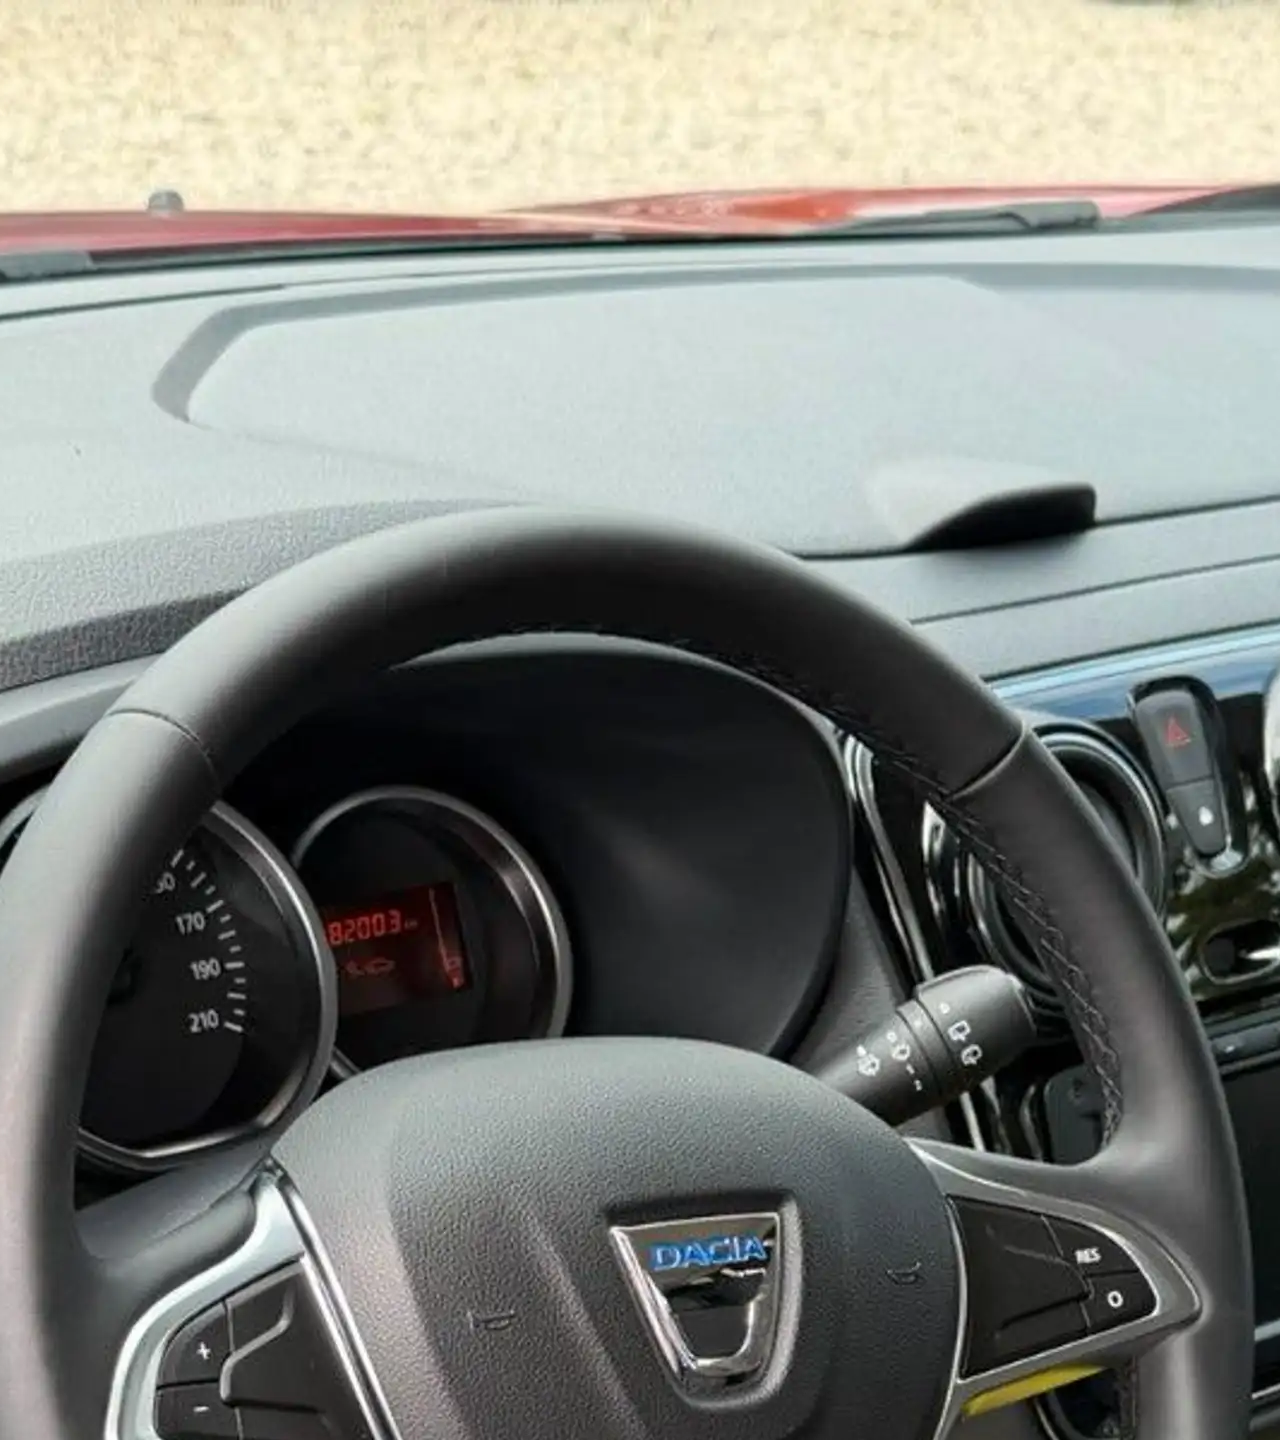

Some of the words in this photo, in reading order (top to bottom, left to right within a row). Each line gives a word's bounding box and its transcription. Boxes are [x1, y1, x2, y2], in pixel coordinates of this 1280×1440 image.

[176, 911, 206, 935] 170
[328, 909, 402, 946] 82003
[190, 957, 220, 980] 190
[188, 1008, 220, 1033] 210
[655, 1236, 767, 1271] DACIA
